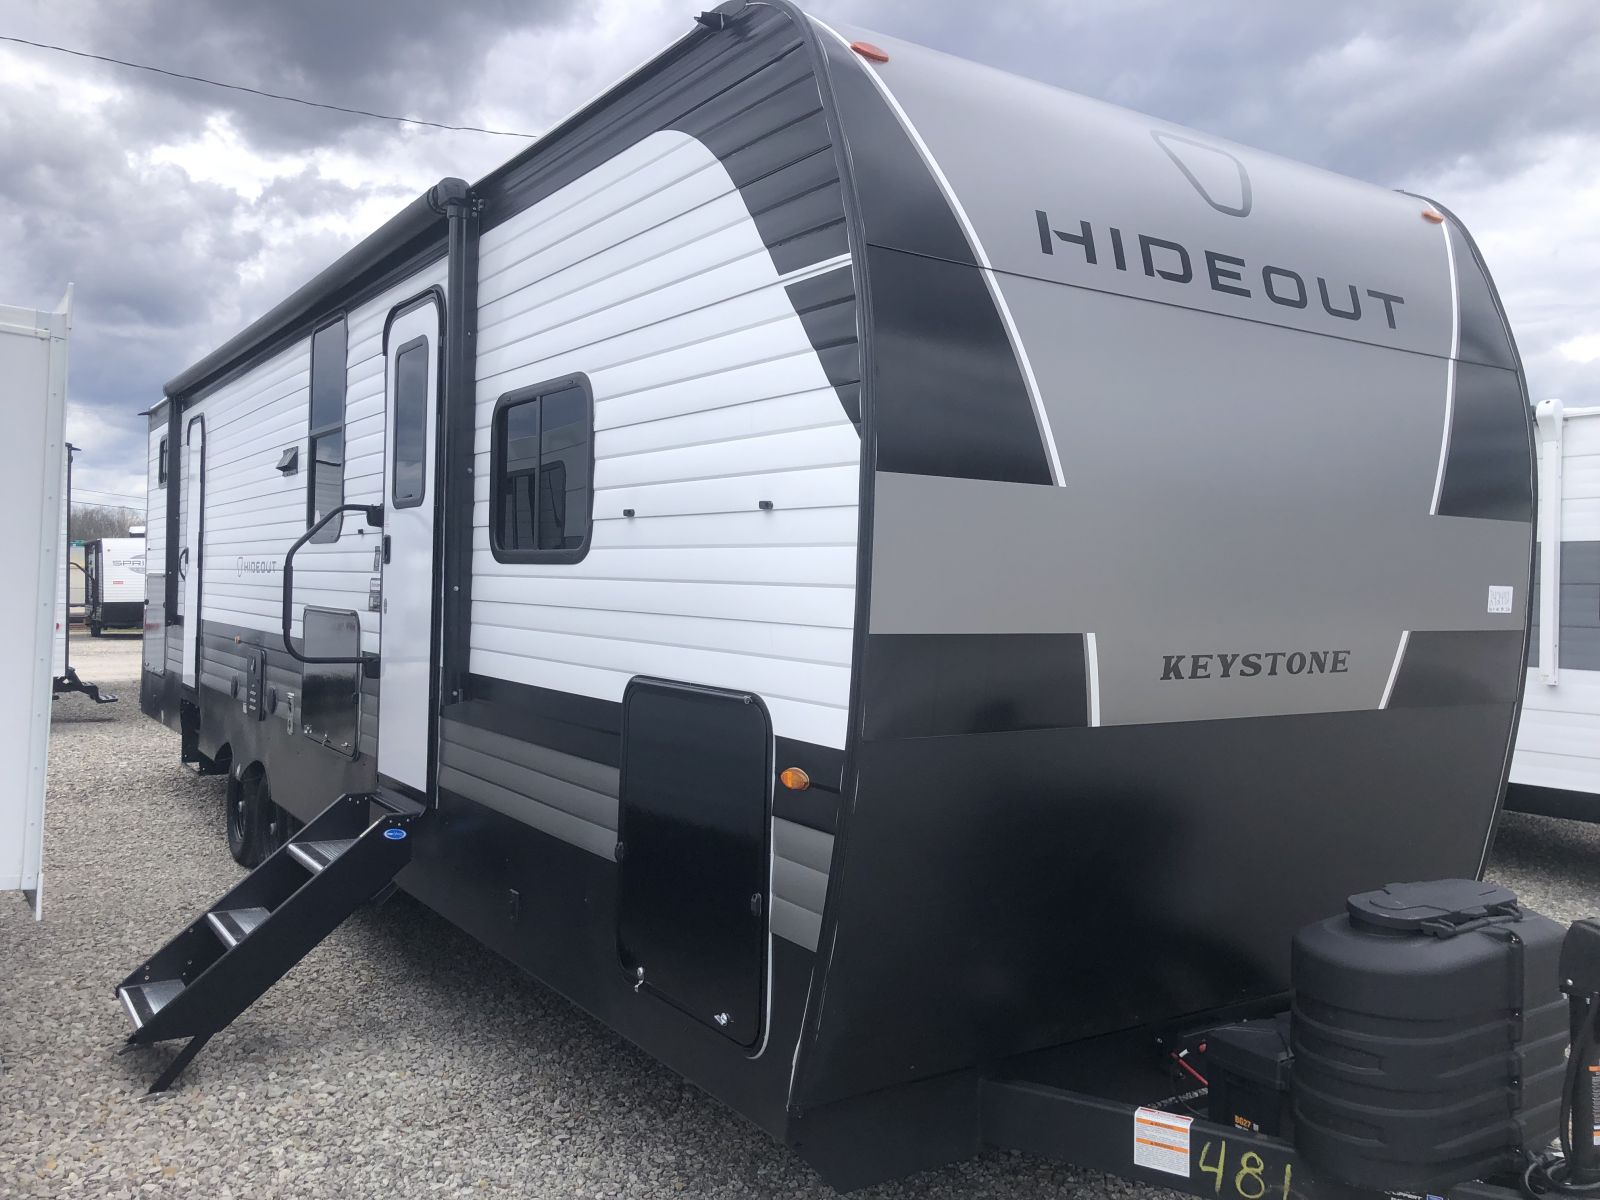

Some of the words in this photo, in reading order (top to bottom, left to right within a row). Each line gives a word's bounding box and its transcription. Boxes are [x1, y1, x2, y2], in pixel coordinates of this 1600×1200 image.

[1035, 209, 1405, 330] HIDEOUT
[244, 561, 277, 573] HIDEOUT
[1160, 650, 1351, 681] KEYSTONE
[1199, 1140, 1292, 1200] 481
